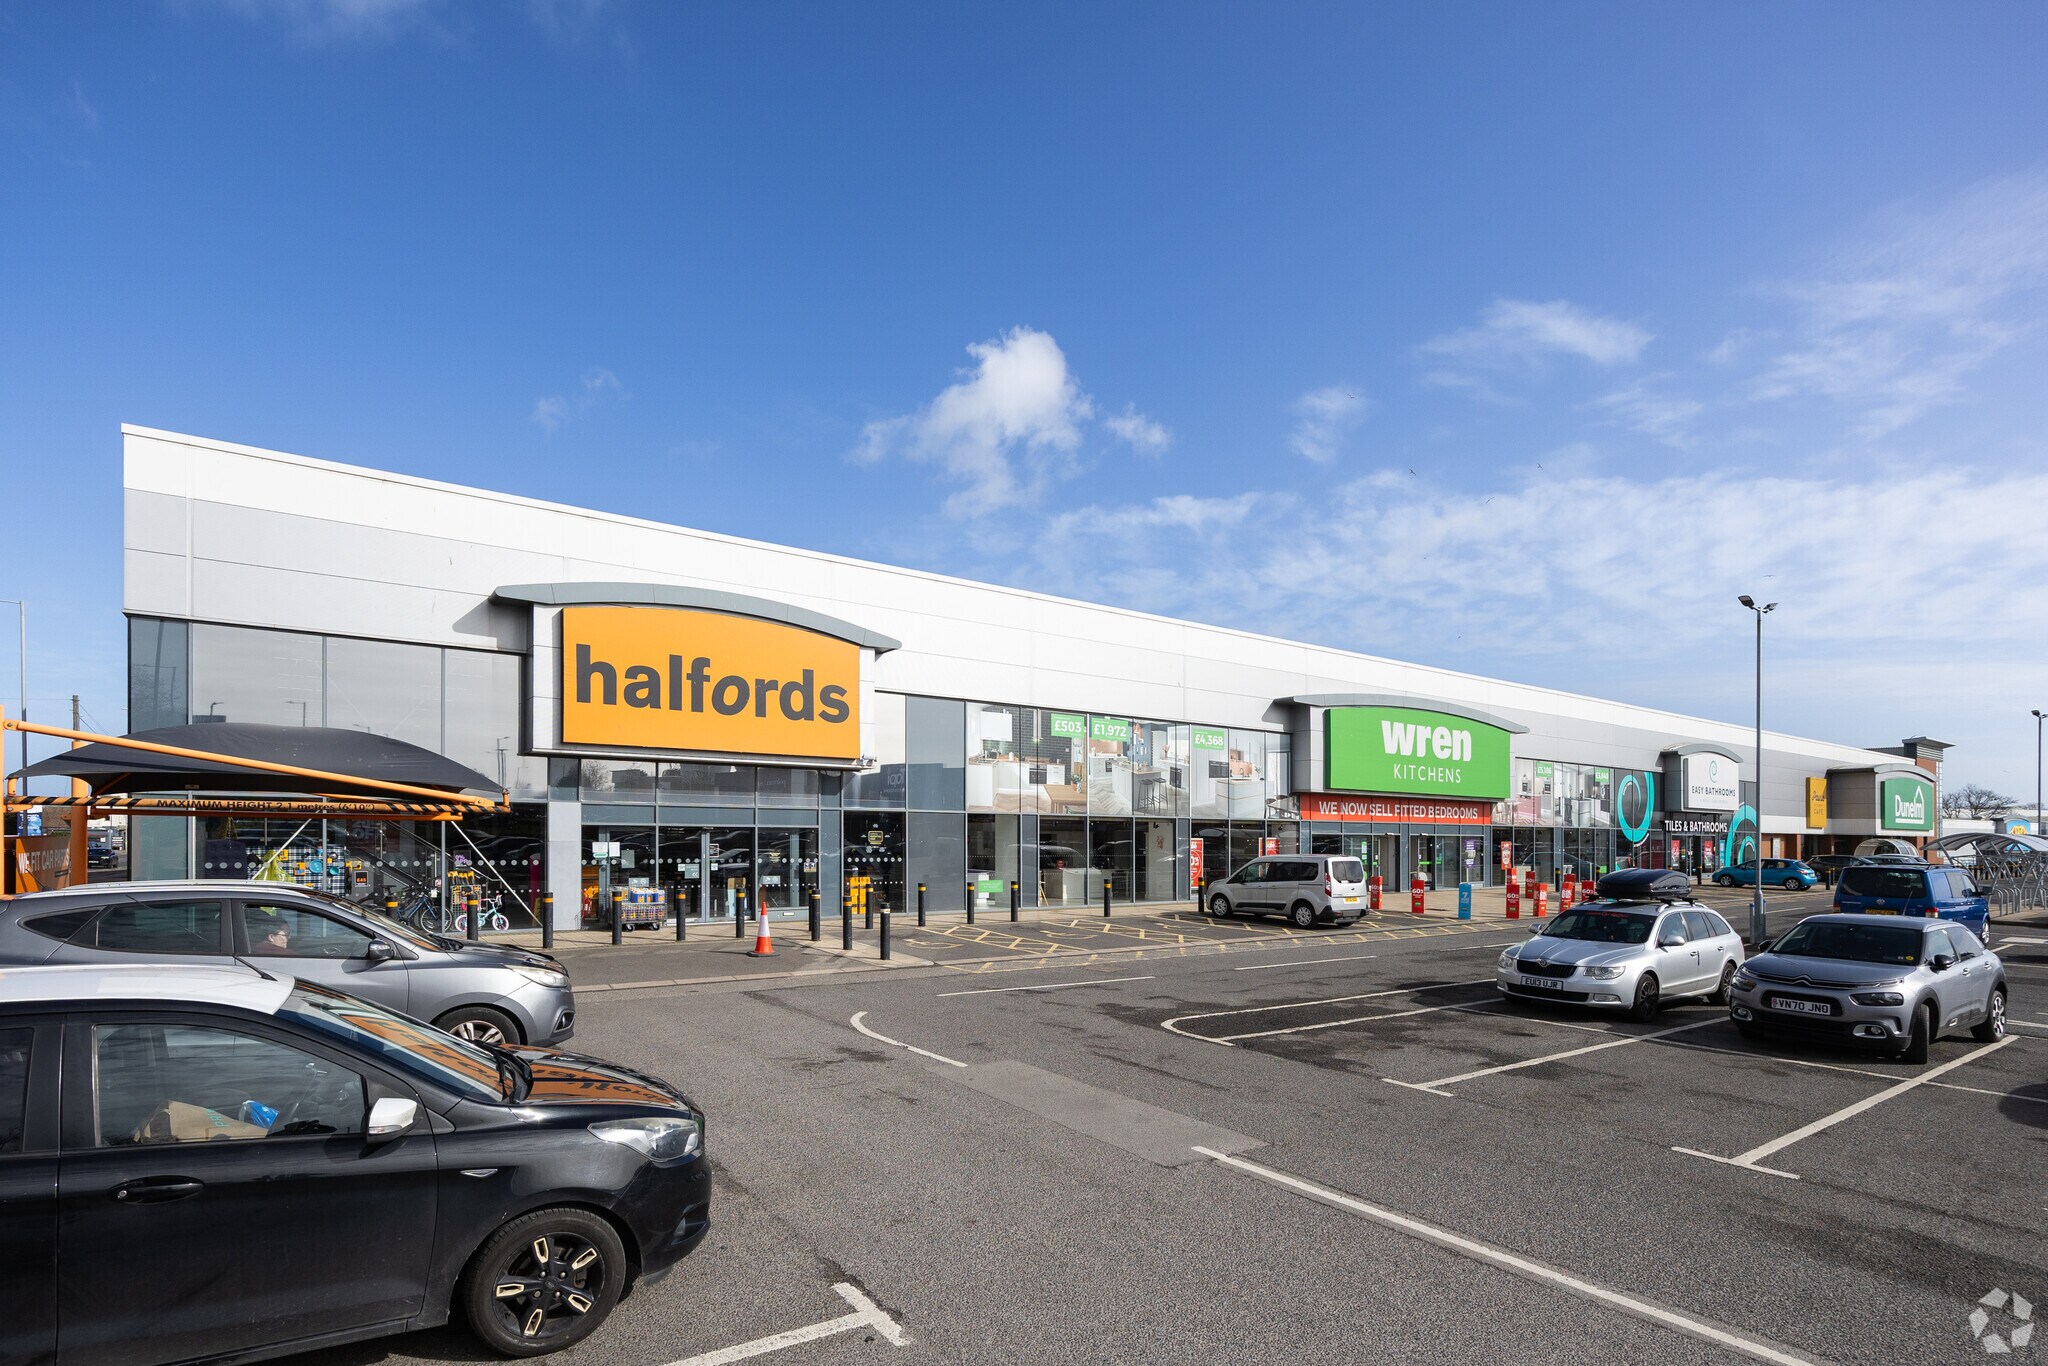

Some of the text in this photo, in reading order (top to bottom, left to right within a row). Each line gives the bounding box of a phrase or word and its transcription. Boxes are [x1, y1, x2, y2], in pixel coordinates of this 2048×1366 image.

[1054, 721, 1082, 733] £503
[1093, 723, 1127, 738] £1,972
[1194, 734, 1224, 746] £4,368
[1381, 720, 1472, 762] wren
[1393, 763, 1461, 784] KITCHENS
[1691, 785, 1736, 797] EASY BATHROOMS
[157, 799, 223, 809] MAXIMUM
[227, 801, 272, 810] HEIGHT
[276, 802, 292, 810] 2.1
[297, 803, 335, 811] metres
[1318, 801, 1478, 820] WE NOW SELL FITTED BEDROOMS
[1894, 791, 1925, 819] Dunelm
[1664, 820, 1728, 833] TILES & BATHROOMS
[18, 852, 30, 874] WE
[31, 851, 41, 872] FIT
[41, 849, 54, 871] CAR
[1525, 978, 1558, 989] EU13 UJR
[1778, 1000, 1805, 1011] VN70
